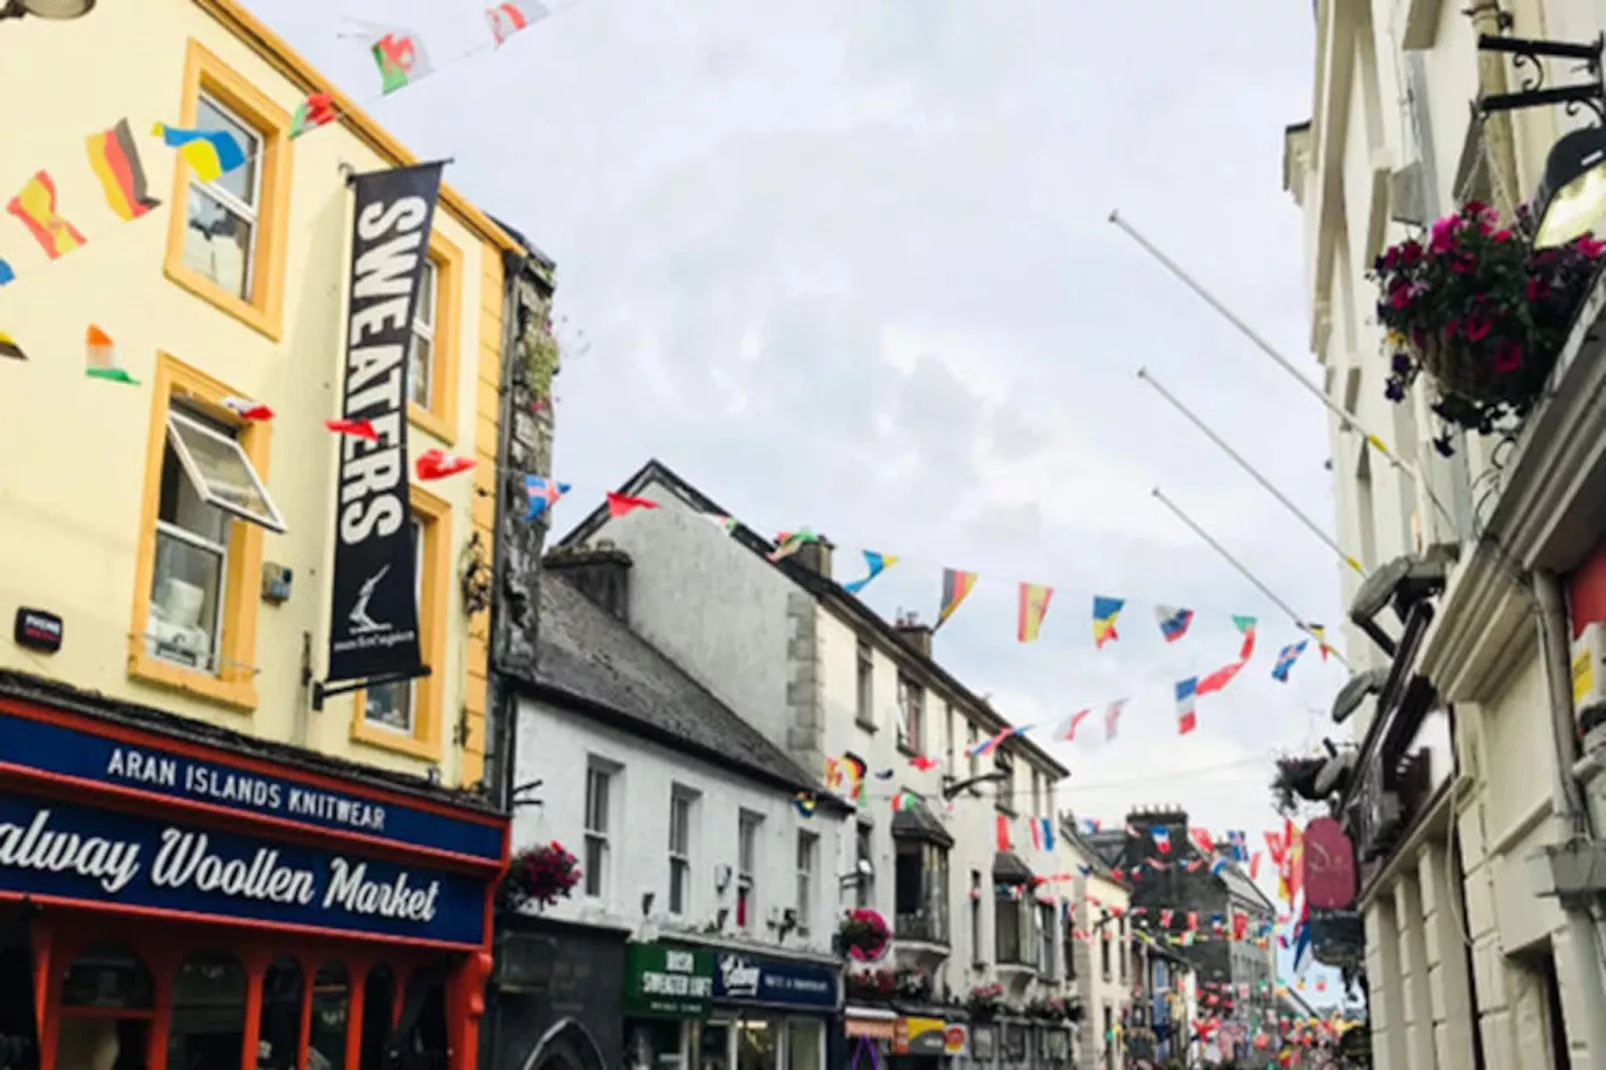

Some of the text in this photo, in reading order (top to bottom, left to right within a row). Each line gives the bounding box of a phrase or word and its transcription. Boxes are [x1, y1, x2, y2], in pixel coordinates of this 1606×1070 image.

[340, 196, 428, 545] SWEATERS
[107, 749, 386, 831] ARAN ISLANDS KNITWEAR
[151, 827, 315, 905] Woollen
[322, 856, 440, 922] Market
